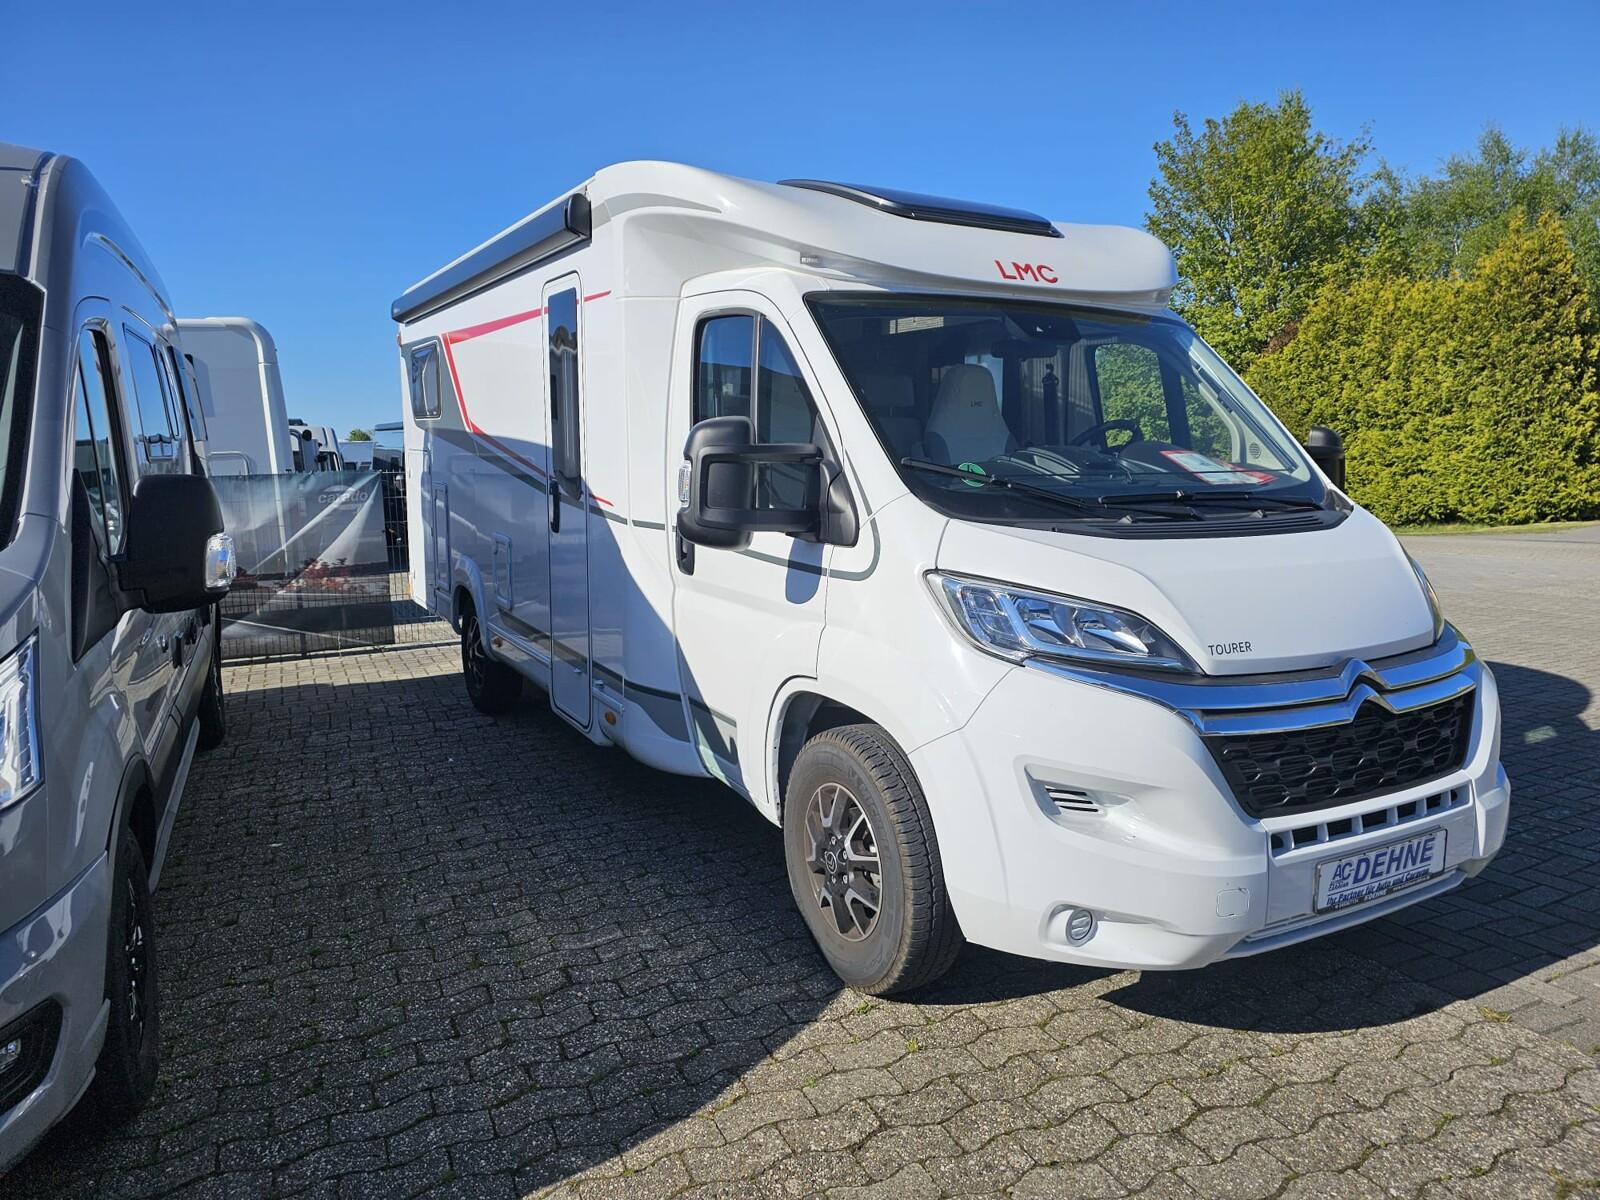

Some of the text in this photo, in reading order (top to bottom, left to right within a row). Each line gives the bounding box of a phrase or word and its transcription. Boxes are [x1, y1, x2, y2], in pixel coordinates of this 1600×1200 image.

[995, 260, 1058, 283] LMC
[318, 490, 368, 503] cado
[1208, 641, 1252, 656] TOURER
[1352, 837, 1435, 884] DEHNE
